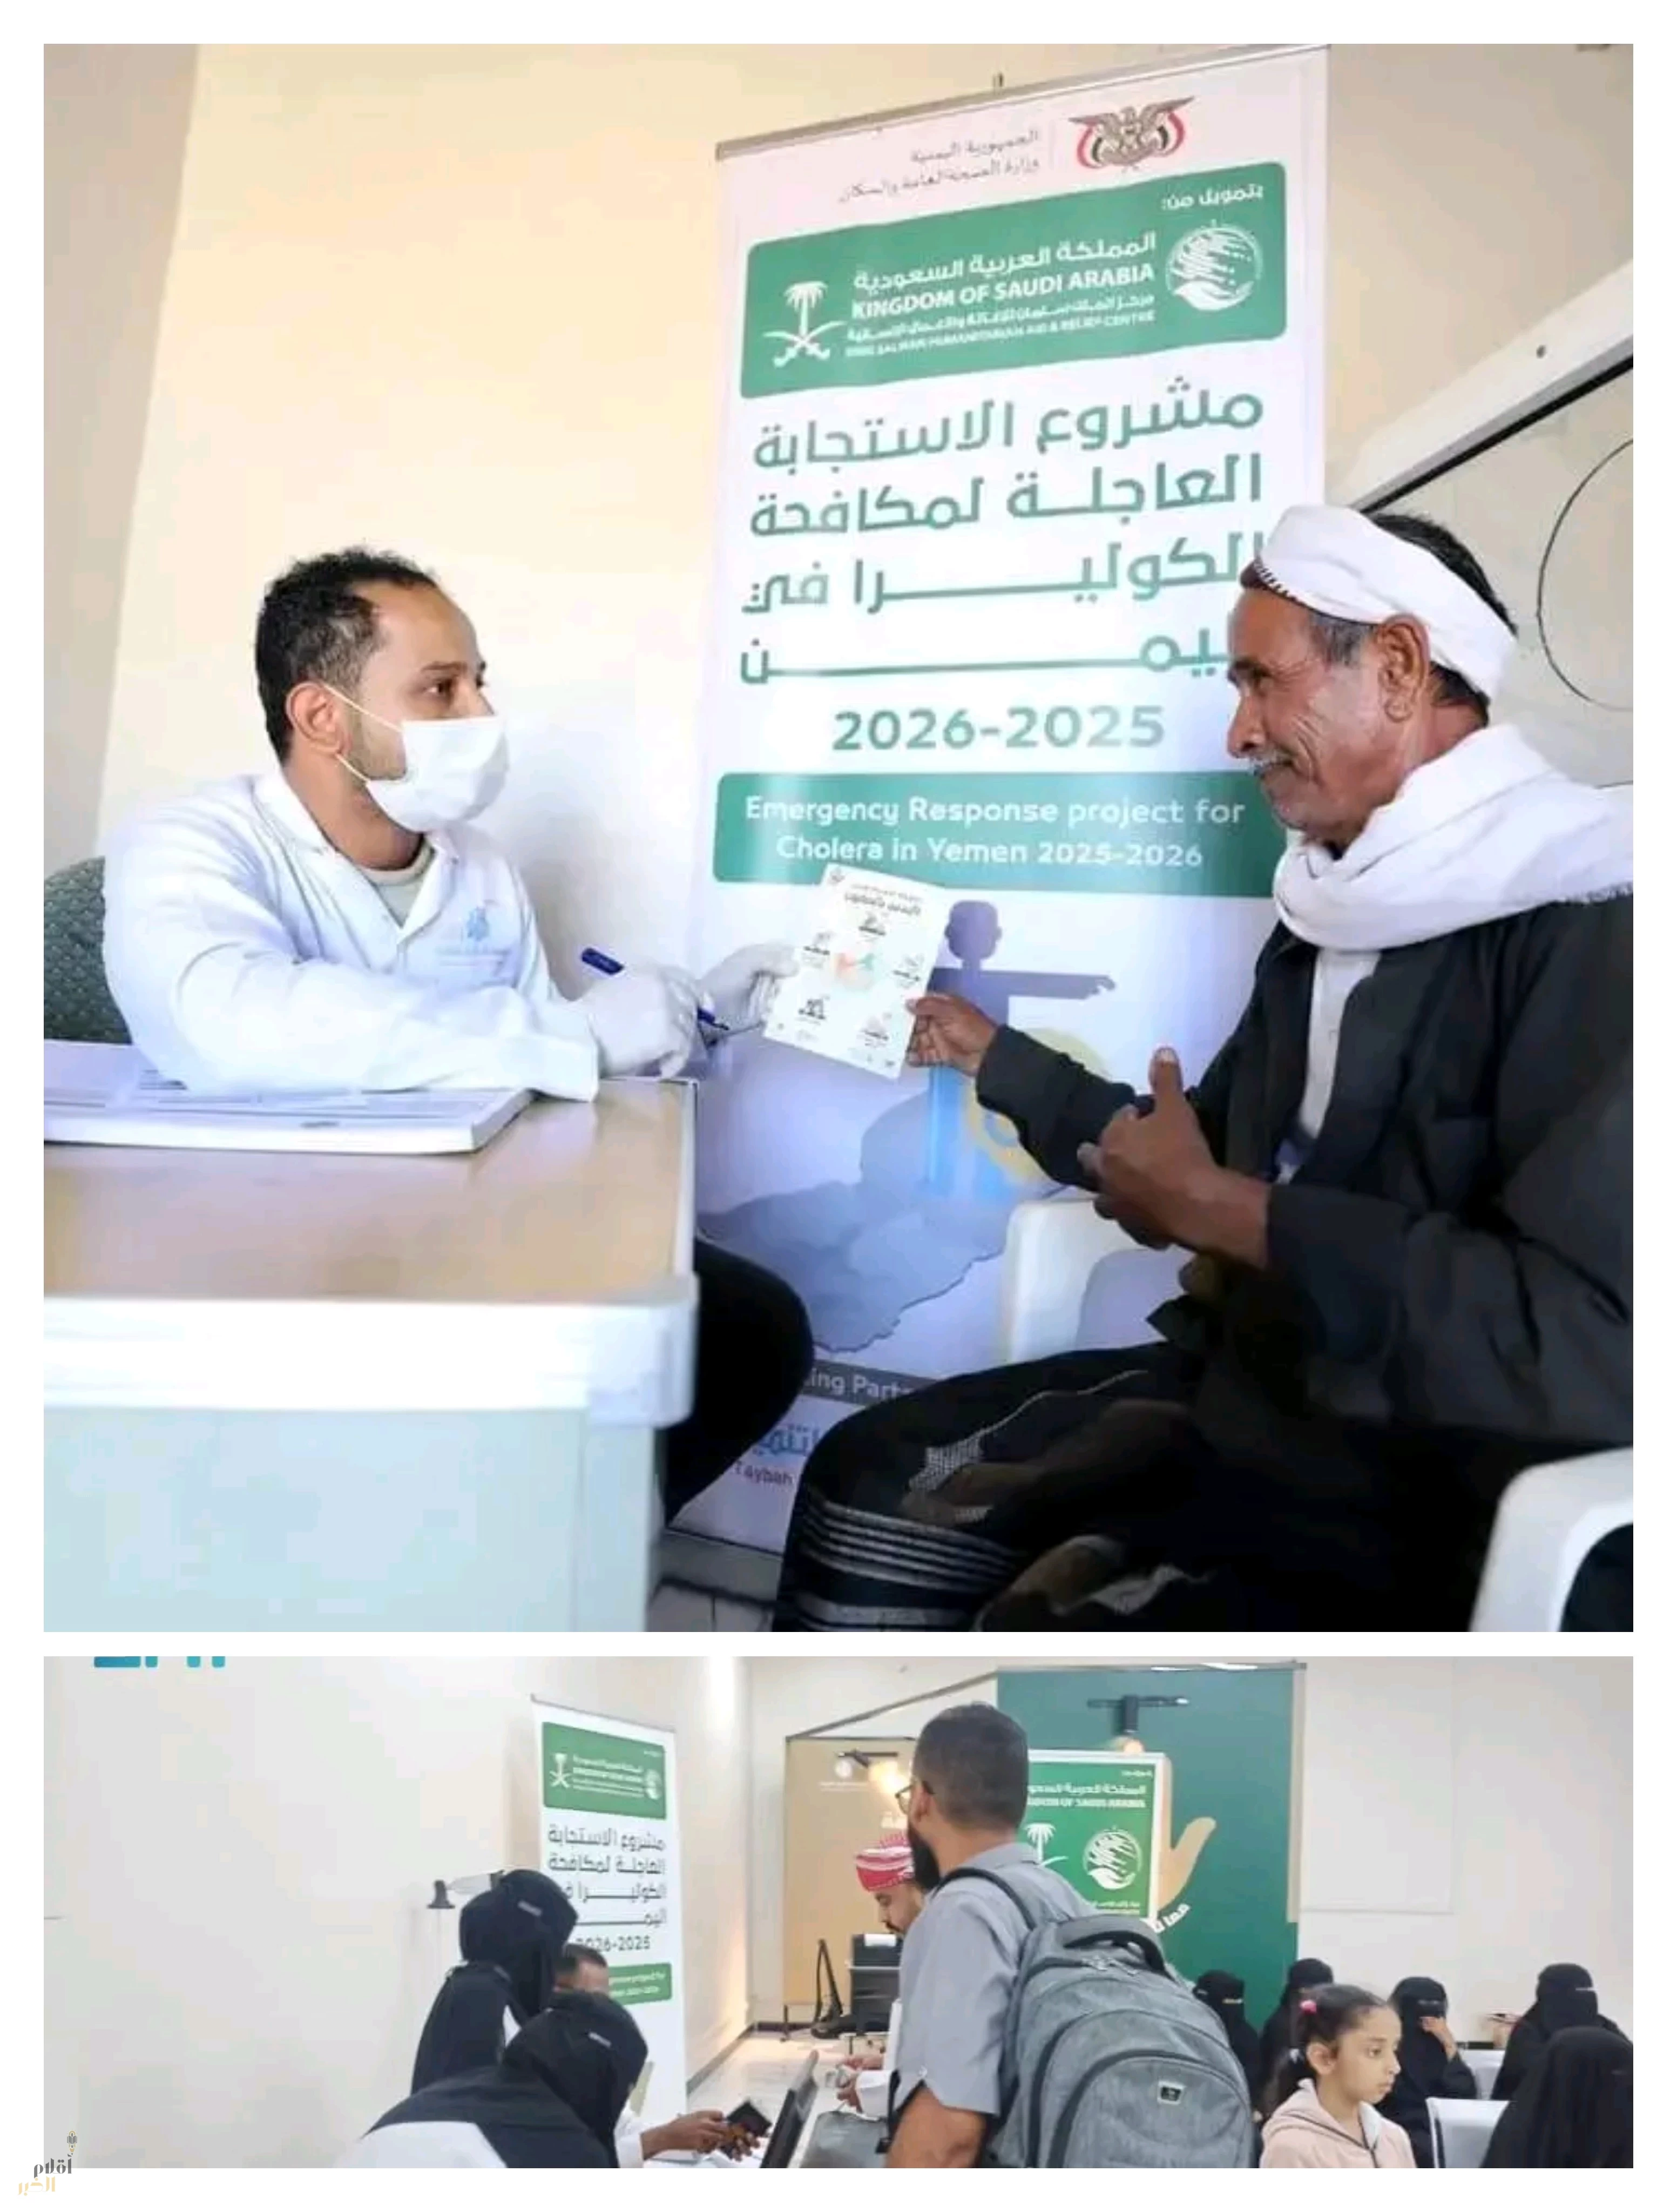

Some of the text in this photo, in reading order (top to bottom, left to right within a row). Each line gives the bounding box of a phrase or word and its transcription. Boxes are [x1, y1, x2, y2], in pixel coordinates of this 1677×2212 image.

[1198, 183, 1264, 205] بتمويل
[854, 231, 1156, 296] المملكة العربية السعودية
[851, 262, 1155, 320] KINGDOM OF SAUDI ARABIA
[753, 375, 1263, 476] مشروع الاستجابة
[750, 453, 1261, 536] العاجلة لمكافحة
[741, 561, 829, 614] في
[741, 628, 1230, 685] يمن
[832, 705, 1165, 751] 2026-2025
[745, 795, 1246, 830] Emergency Response project for
[775, 834, 1203, 867] Cholera in Yemen 2025-2026
[805, 1367, 846, 1396] ing
